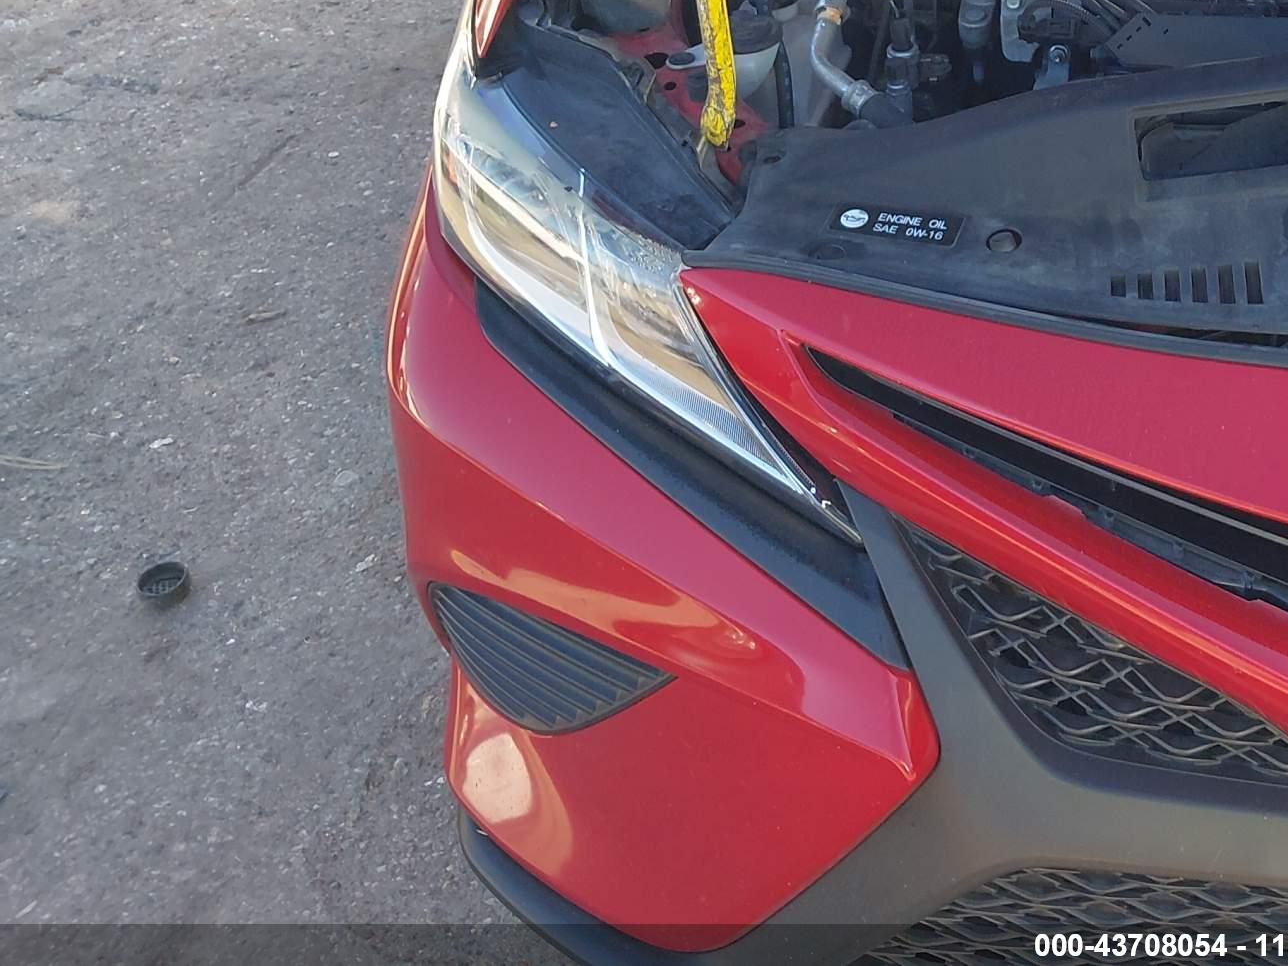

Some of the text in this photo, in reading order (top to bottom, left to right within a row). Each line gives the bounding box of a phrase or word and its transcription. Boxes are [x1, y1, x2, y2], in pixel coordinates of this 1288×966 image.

[878, 212, 947, 230] ENGINE OIL
[873, 223, 943, 240] SAE 0W-16
